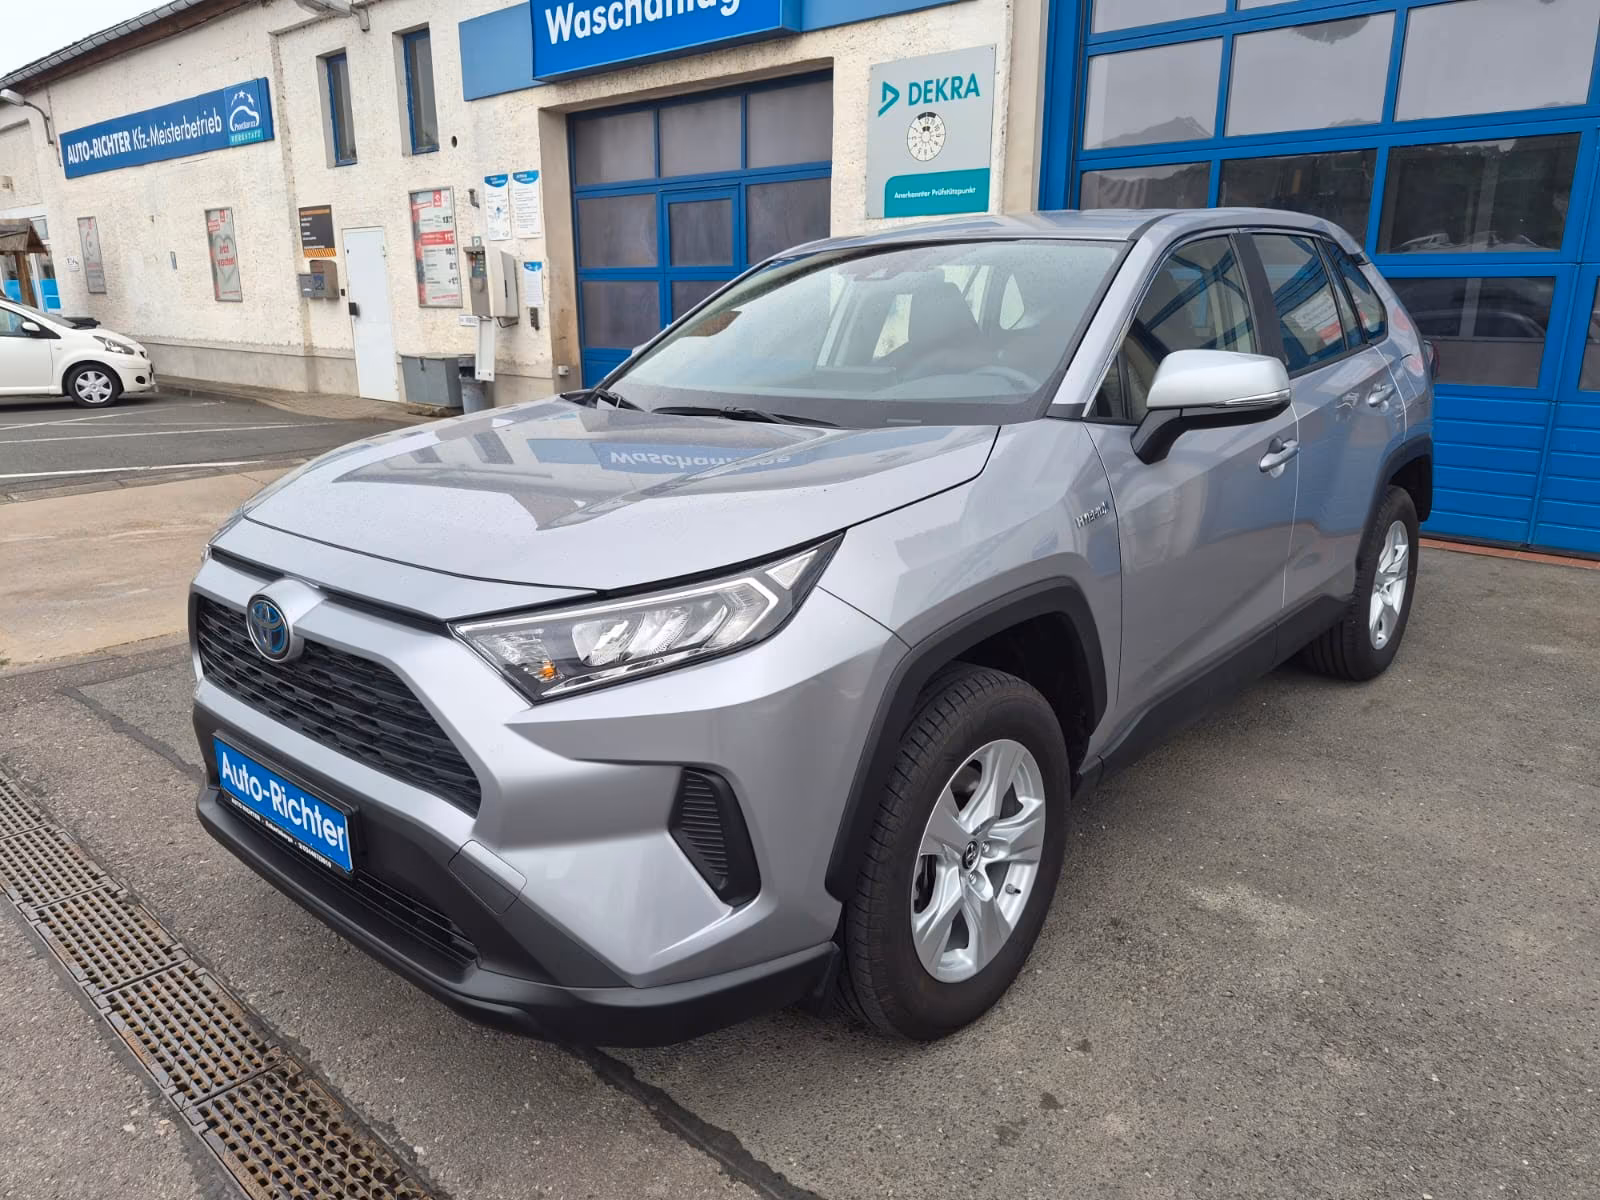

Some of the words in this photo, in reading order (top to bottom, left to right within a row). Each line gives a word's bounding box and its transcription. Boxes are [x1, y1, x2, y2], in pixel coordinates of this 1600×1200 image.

[908, 72, 980, 106] DEKRA
[67, 131, 132, 164] AUTO-RICHTER
[132, 107, 222, 150] Kfz-Meisterbetrieb
[894, 190, 930, 199] Anerkannter
[222, 751, 344, 852] Auto-Richter
